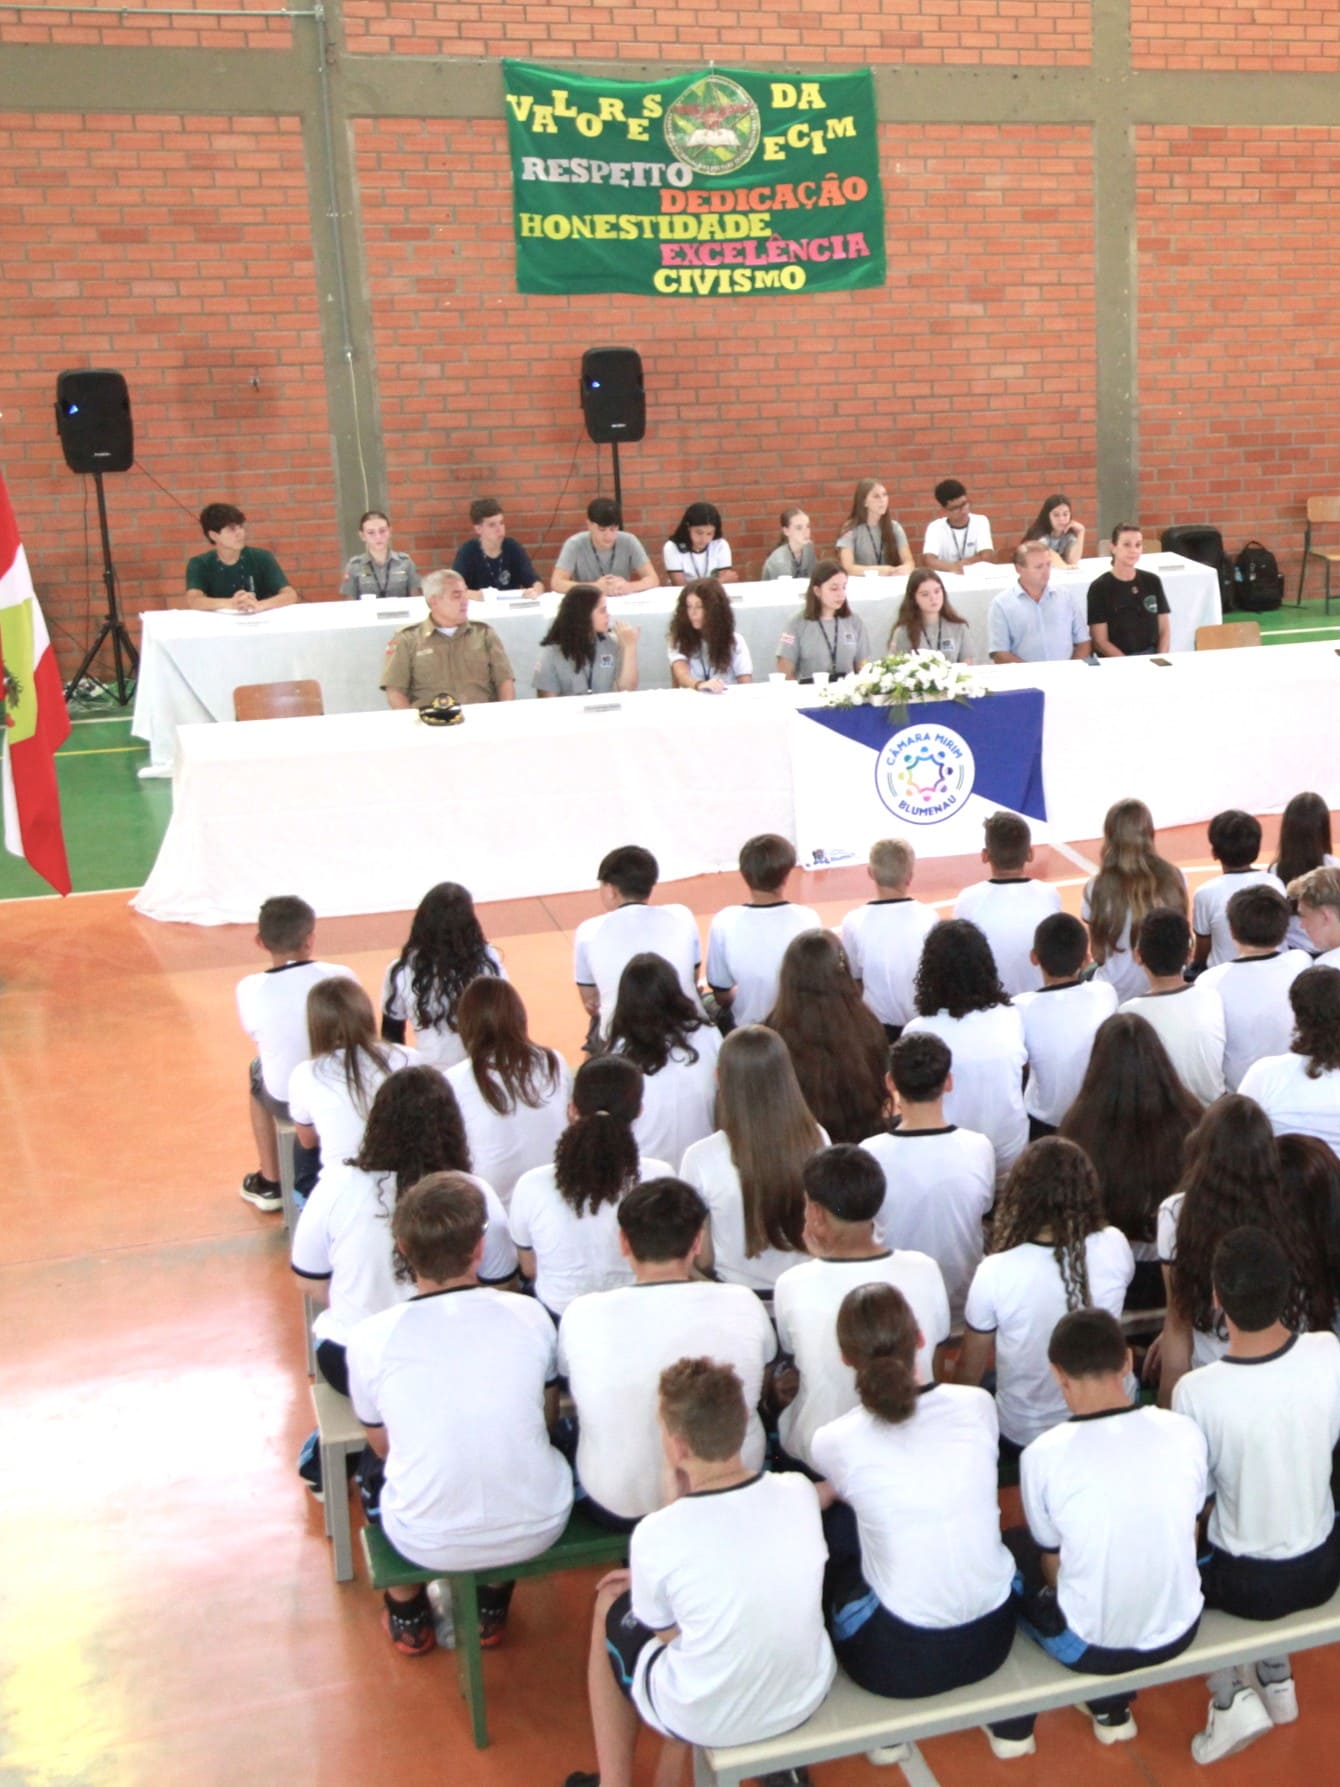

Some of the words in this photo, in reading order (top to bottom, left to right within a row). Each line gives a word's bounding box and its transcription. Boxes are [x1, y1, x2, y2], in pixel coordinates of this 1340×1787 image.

[507, 90, 662, 142] VALORES
[770, 83, 827, 110] DA
[763, 116, 857, 161] ECIM
[522, 157, 694, 188] RESPEITO
[519, 212, 772, 241] HONESTIDADE
[660, 232, 870, 266] EXCELÊNCIA
[653, 265, 806, 295] CIVISMO
[886, 732, 930, 766] CÂMARA
[934, 733, 964, 759] MIRIM
[898, 794, 957, 817] BLUMENAU
